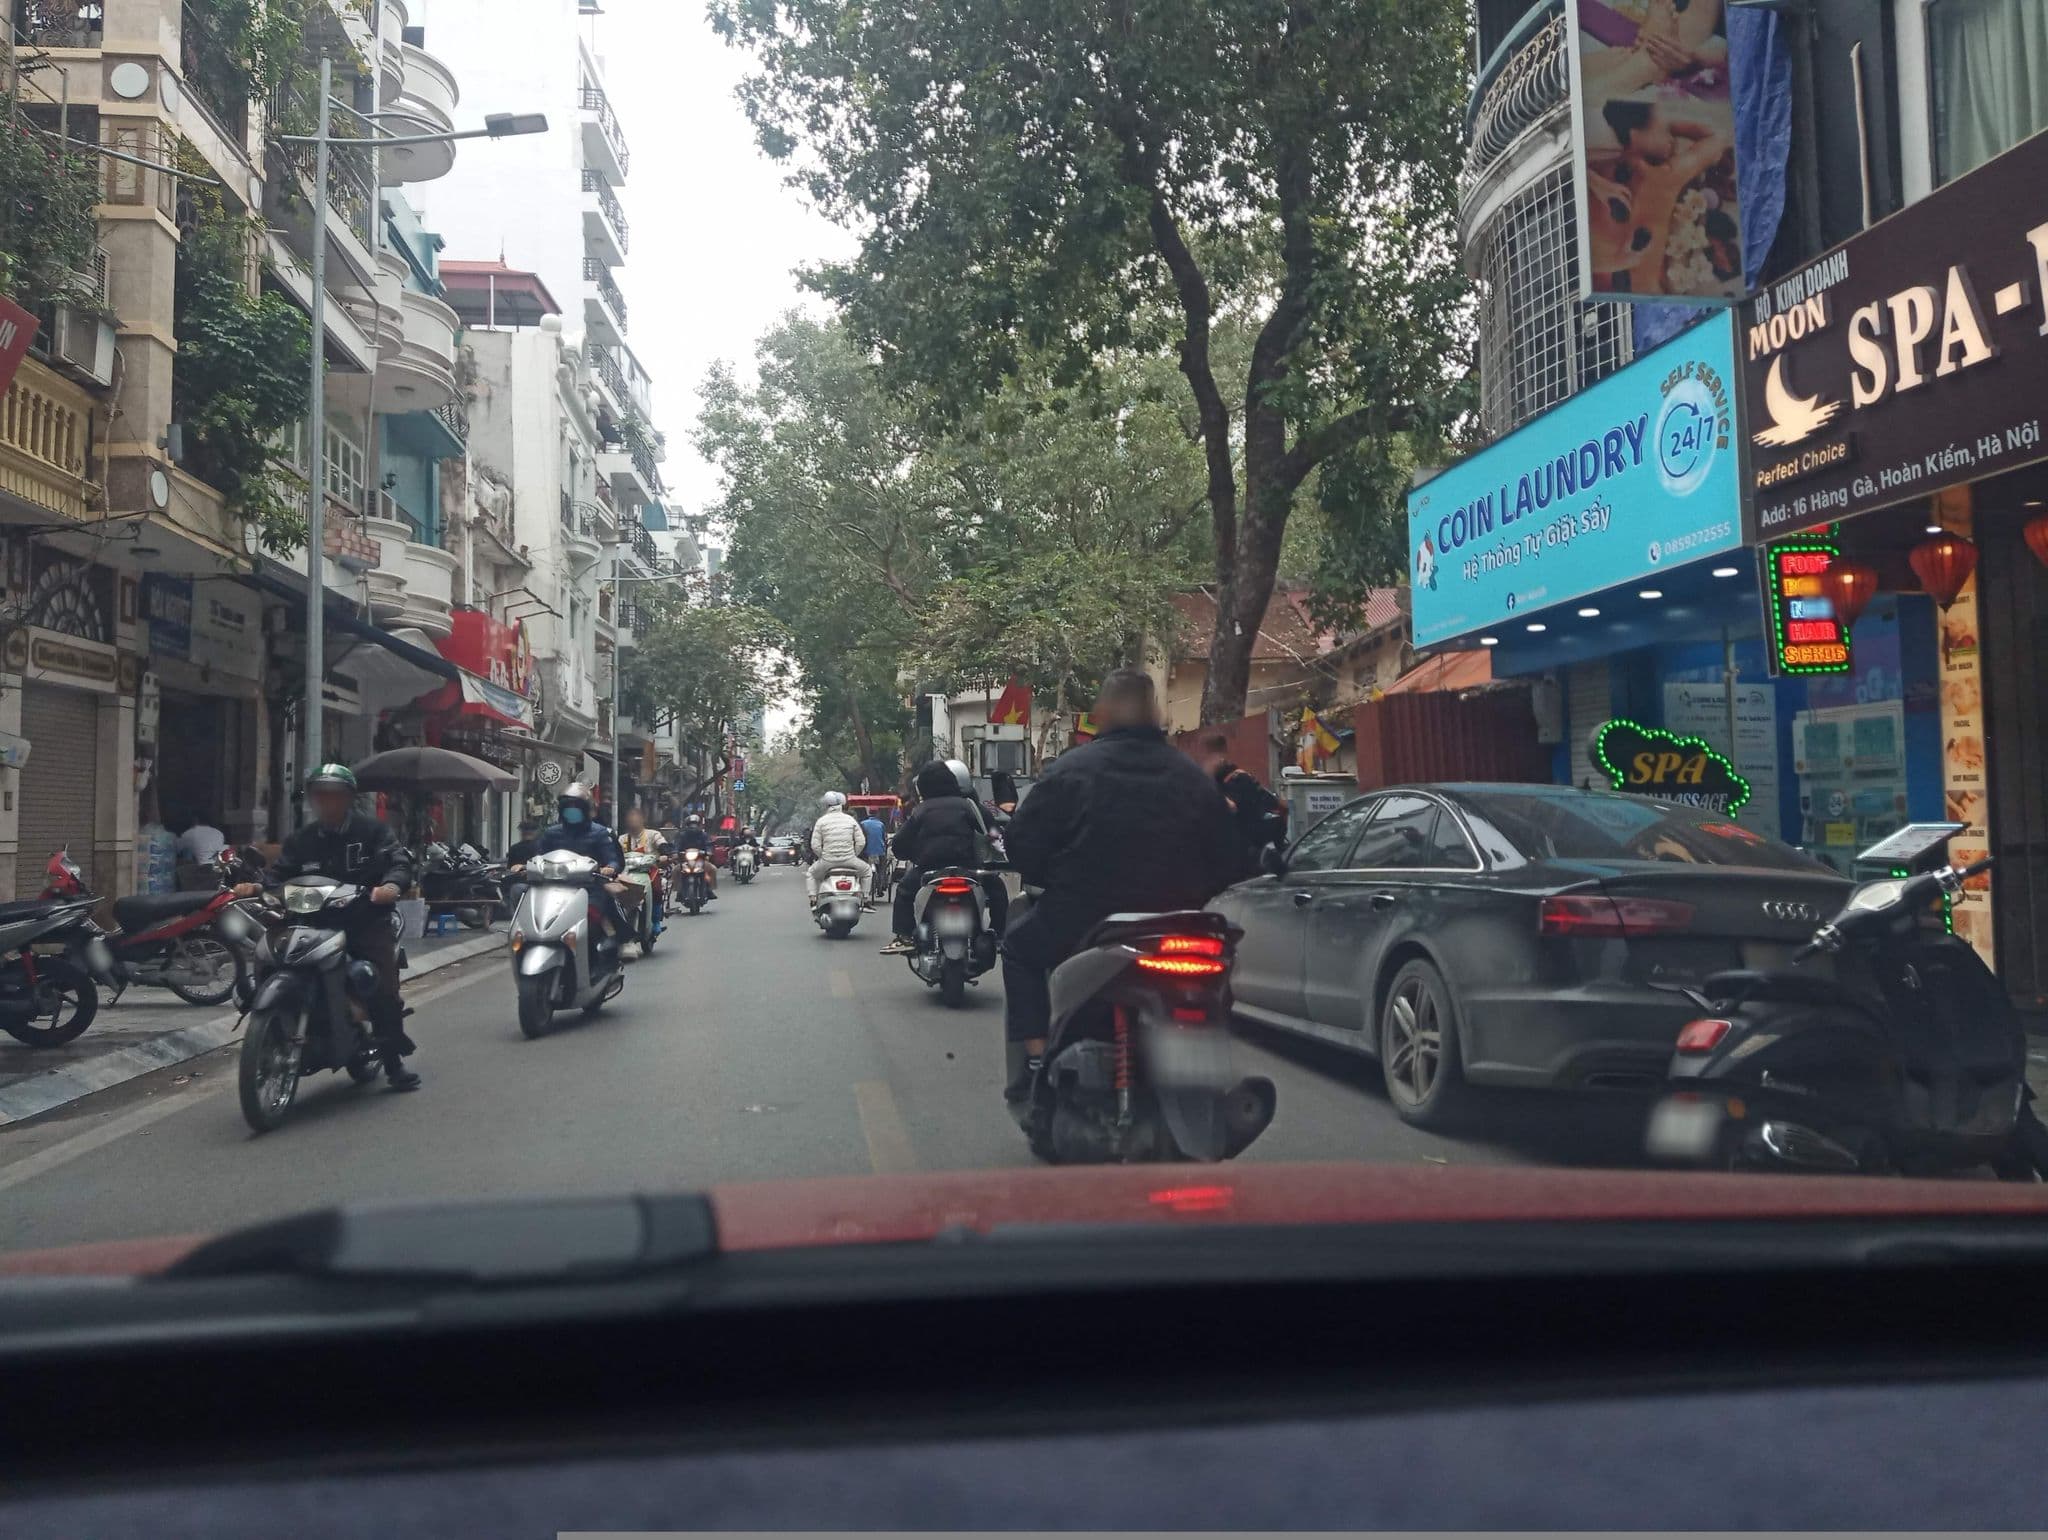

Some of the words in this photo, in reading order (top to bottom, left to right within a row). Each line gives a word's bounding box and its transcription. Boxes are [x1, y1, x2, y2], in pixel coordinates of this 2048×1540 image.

[1776, 273, 1805, 312] KINH
[1805, 249, 1849, 297] DOANH
[1750, 293, 1826, 361] MOON
[1660, 360, 1695, 399] SELF
[1696, 361, 1731, 450] SERVICE
[1671, 415, 1714, 457] 24/7
[1438, 490, 1494, 554] COIN
[1500, 413, 1648, 526] LAUNDRY
[1756, 457, 1799, 488] Perfect
[1801, 442, 1847, 471] Choice
[1761, 503, 1792, 528] Add:
[1793, 497, 1807, 516] 16
[1810, 487, 1848, 512] Hàng
[1853, 475, 1879, 498] Gà,
[1880, 462, 1922, 489] Hoàn
[1925, 443, 1976, 476] Kiếm,
[1977, 433, 2002, 459] Hà
[2006, 420, 2040, 450] Nội
[1785, 645, 1848, 664] SCRUB
[1788, 621, 1837, 642] HAIR
[1629, 752, 1707, 784] SPA
